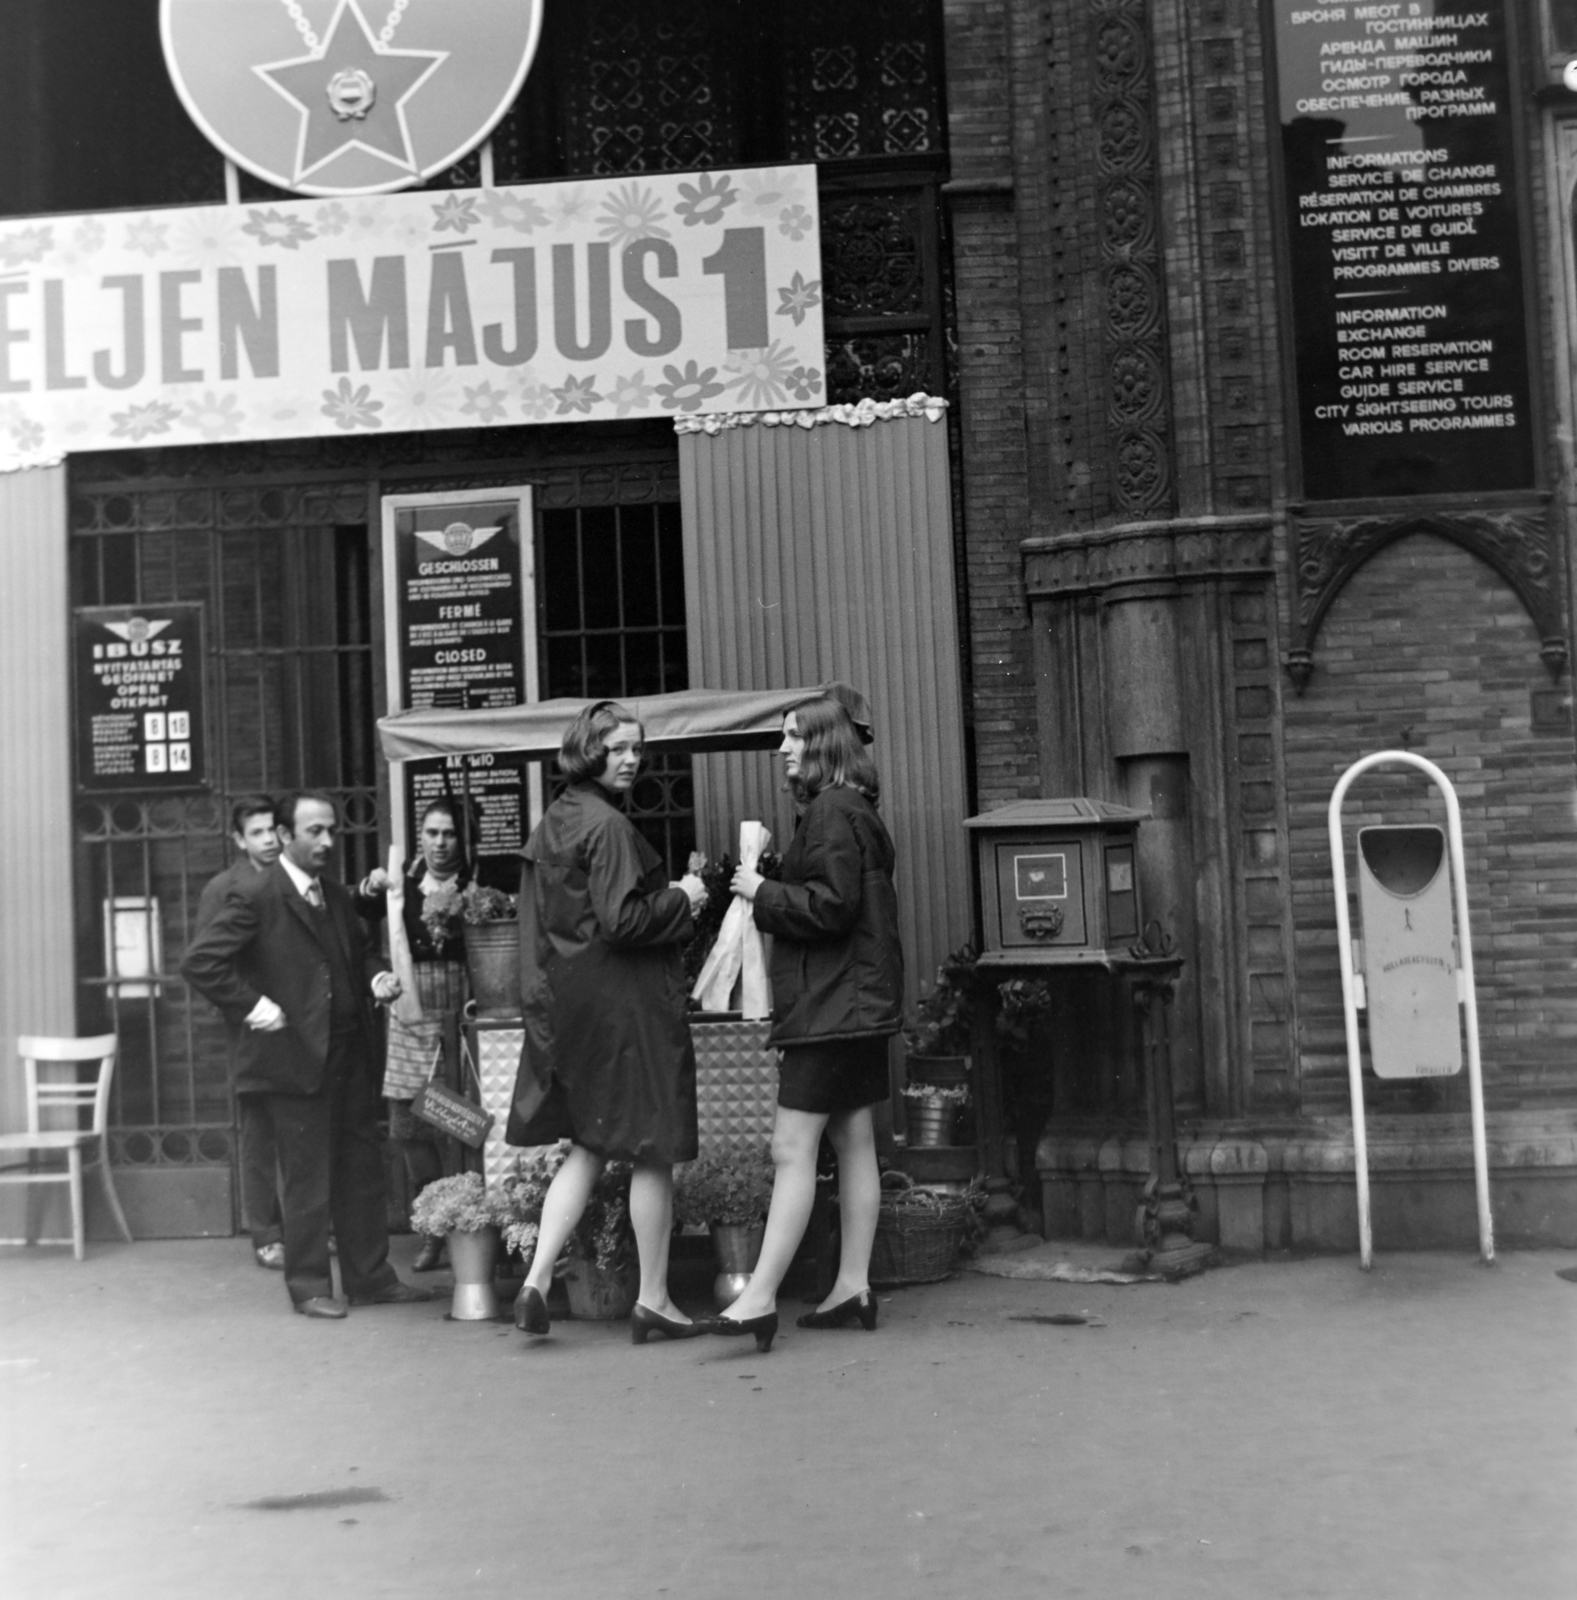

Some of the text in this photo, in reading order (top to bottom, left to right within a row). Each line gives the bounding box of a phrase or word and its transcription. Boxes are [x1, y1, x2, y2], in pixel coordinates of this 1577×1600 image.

[1291, 8, 1346, 24] БРОНЯ
[1409, 3, 1420, 16] В
[1320, 34, 1458, 56] АРЕНДА МАШИН
[1320, 50, 1492, 74] ГИДЫ-ПЕРЕВОДЧИКИ
[1322, 70, 1467, 92] ОСМОТР ГОРОДА
[1296, 87, 1485, 112] ОБЕСПЕЧЕНИЕ РАЗНЫХ
[1405, 102, 1496, 120] ПРОГРАММ
[1326, 149, 1448, 170] INFORMATIONS
[1328, 164, 1496, 188] SERVICE DE CHANGE
[1299, 183, 1501, 208] RÉSERVATION DE CHAMBRES
[1300, 202, 1483, 227] LOKATION DE VOITURES
[1332, 226, 1396, 242] SERVICE
[1401, 224, 1422, 239] DE
[1384, 243, 1406, 258] DE
[1411, 241, 1450, 256] VILLE
[1333, 256, 1500, 280] PROGRAMMES DIVERS
[702, 226, 770, 350] 1
[1336, 305, 1447, 324] INFORMATION
[1337, 325, 1426, 343] EXCHANGE
[1338, 340, 1492, 361] ROOM RESERVATION
[1339, 358, 1489, 380] CAR HIRE SERVICE
[1340, 378, 1464, 399] GUIDE SERVICE
[1315, 404, 1350, 419] CITY
[1460, 395, 1514, 410] TOURS
[1342, 413, 1516, 436] VARIOUS PROGRAMMES
[439, 603, 482, 620] FERMÉ
[93, 639, 183, 659] IBUSZ
[435, 649, 487, 664] CLOSED
[117, 683, 160, 697] OPEN
